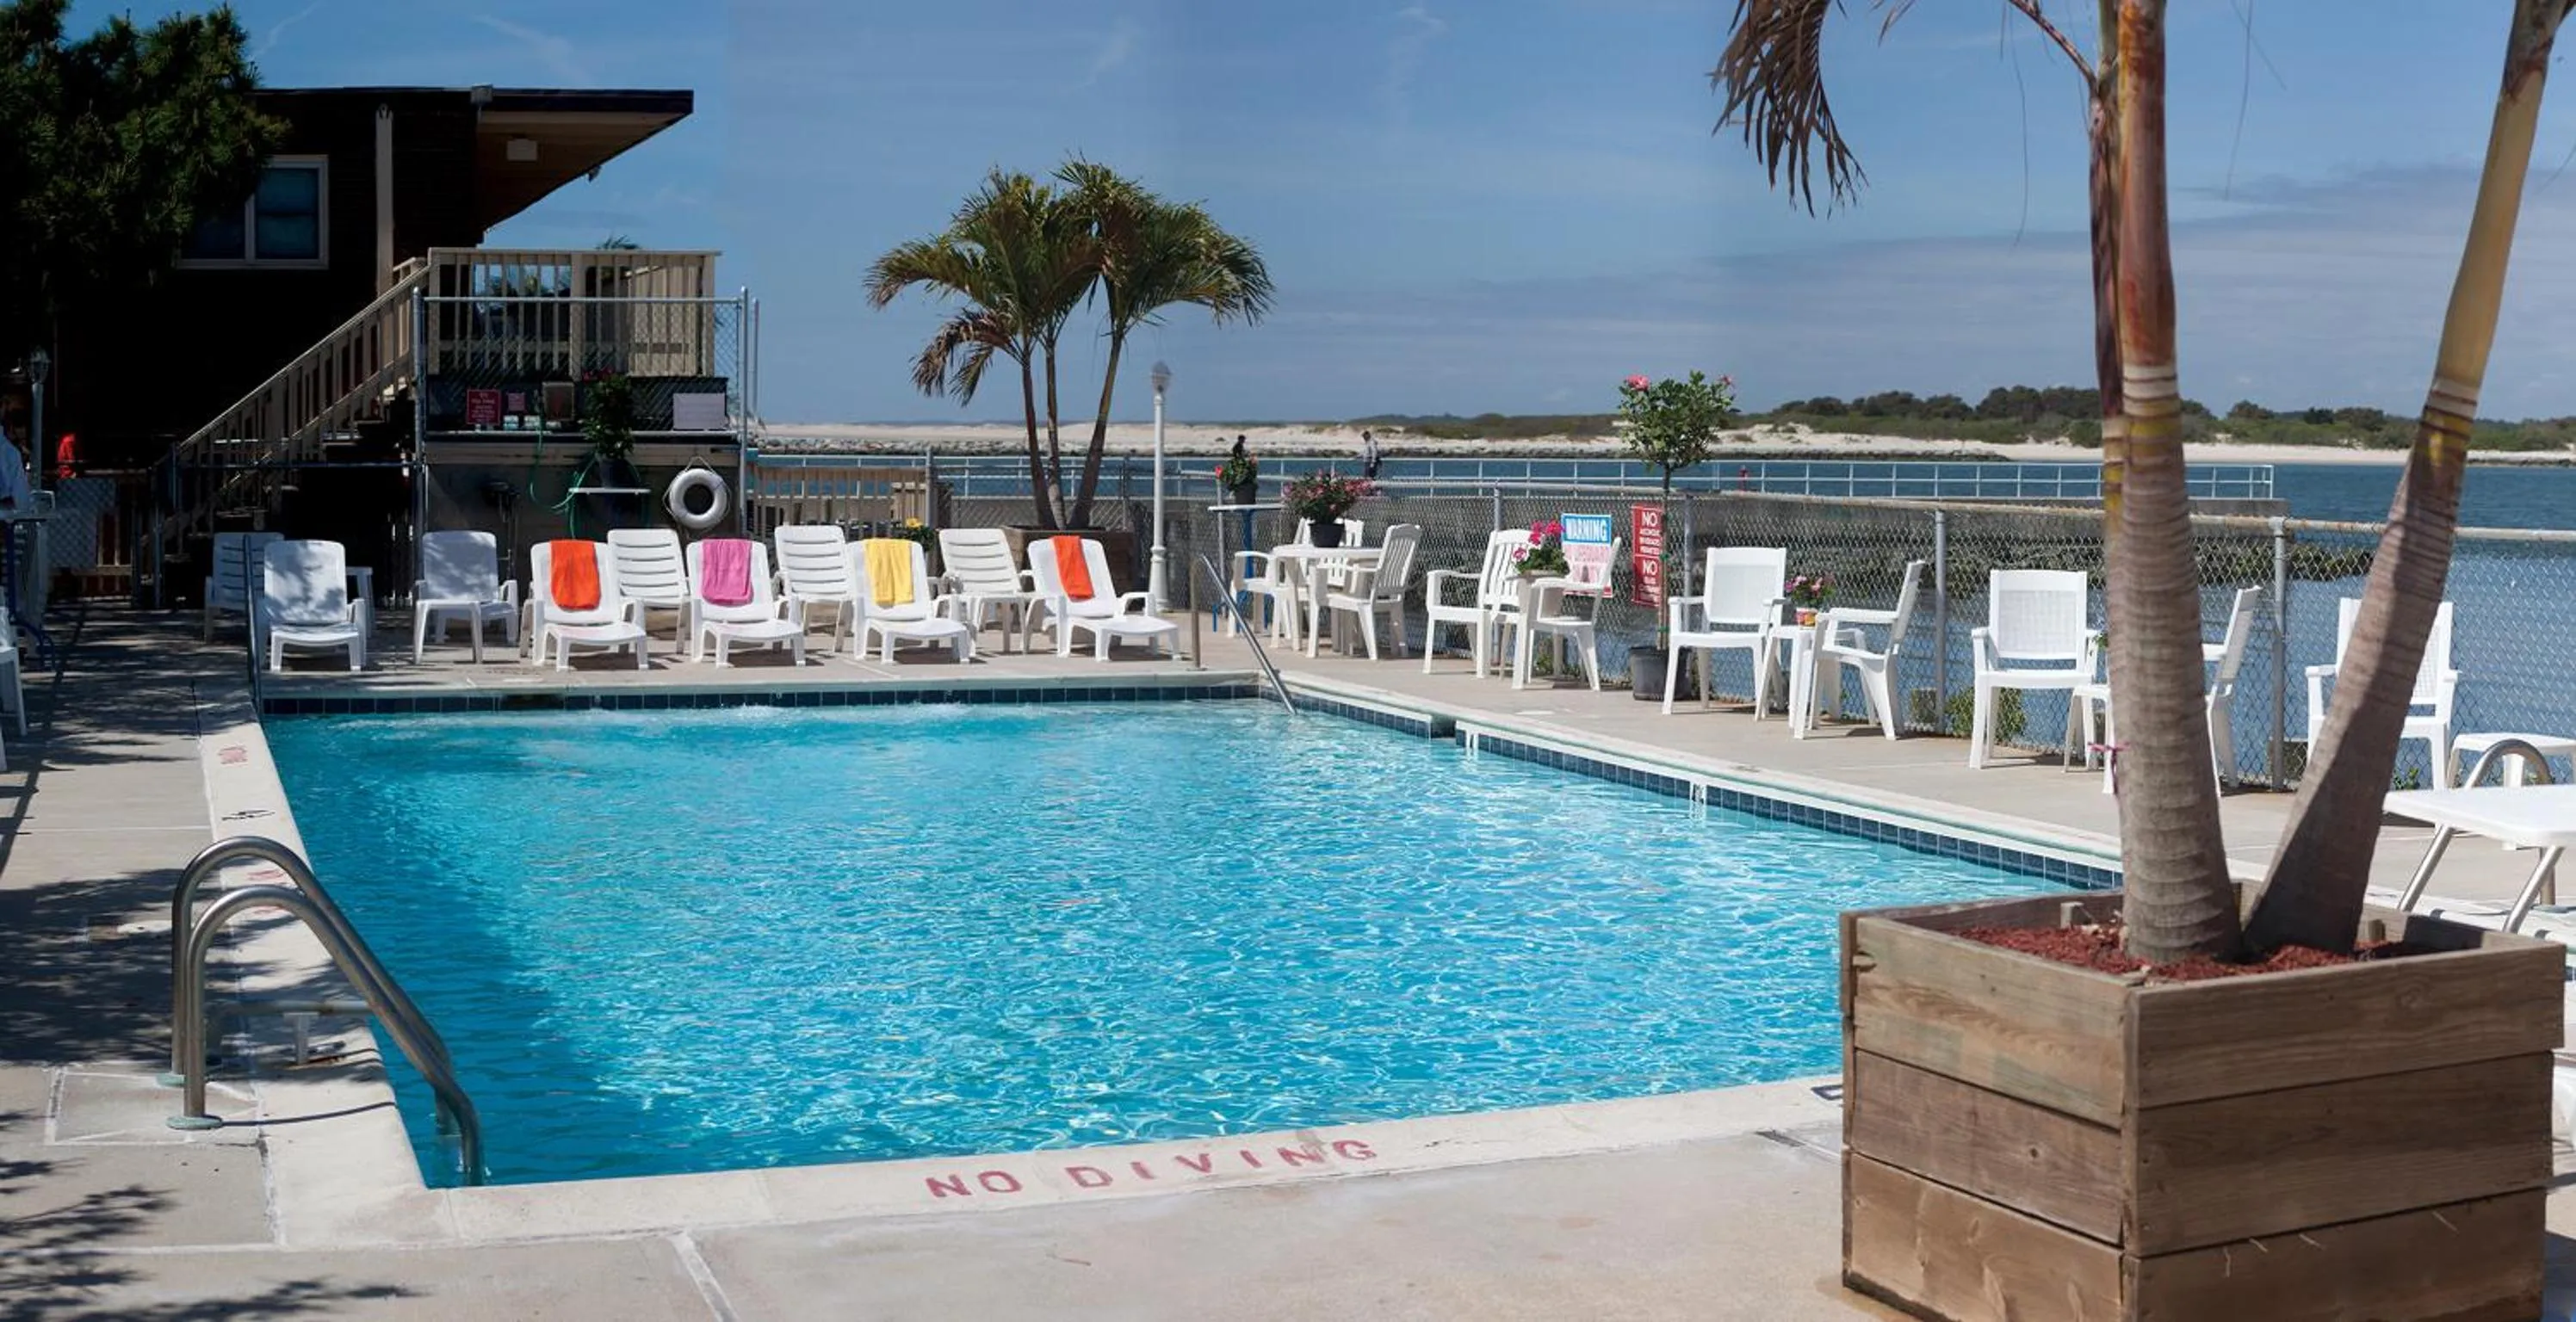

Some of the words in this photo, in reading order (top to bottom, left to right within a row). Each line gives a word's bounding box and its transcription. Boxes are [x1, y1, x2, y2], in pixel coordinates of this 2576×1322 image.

[1565, 517, 1607, 541] WARNING
[1642, 512, 1657, 527] NO
[1643, 560, 1657, 576] NO
[926, 1171, 1023, 1197] NO
[1064, 1140, 1377, 1189] DIVING
